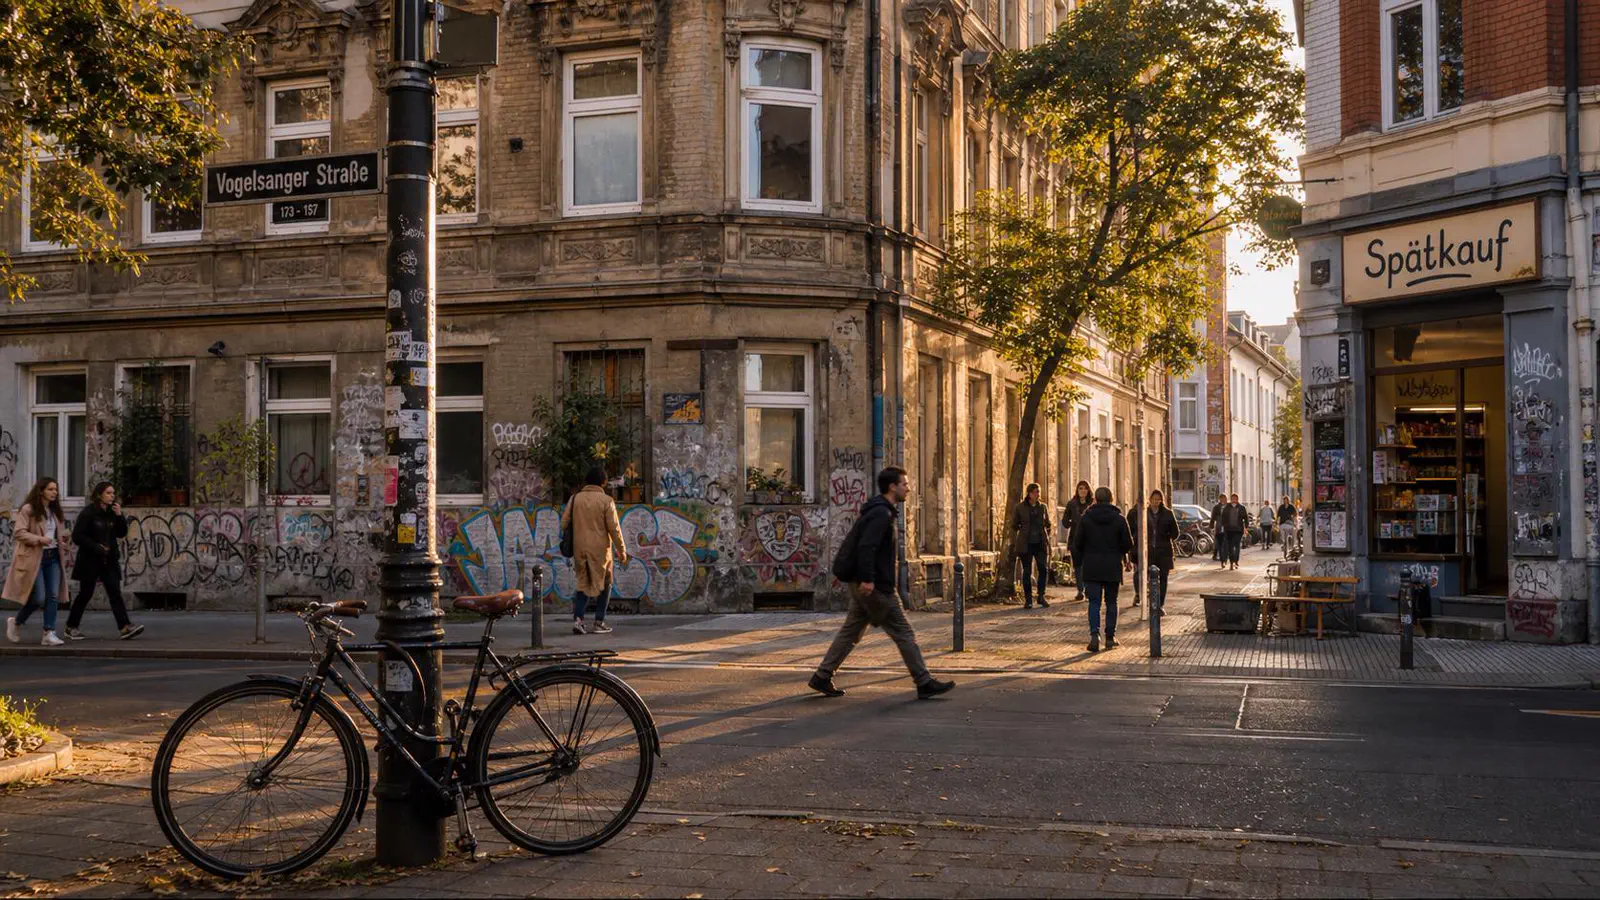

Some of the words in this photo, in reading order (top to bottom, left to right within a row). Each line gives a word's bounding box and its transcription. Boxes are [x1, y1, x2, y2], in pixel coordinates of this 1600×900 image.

[216, 169, 309, 198] Vogelsanger
[316, 160, 369, 186] Straße
[280, 205, 295, 218] 173
[1365, 218, 1512, 288] Spätkauf
